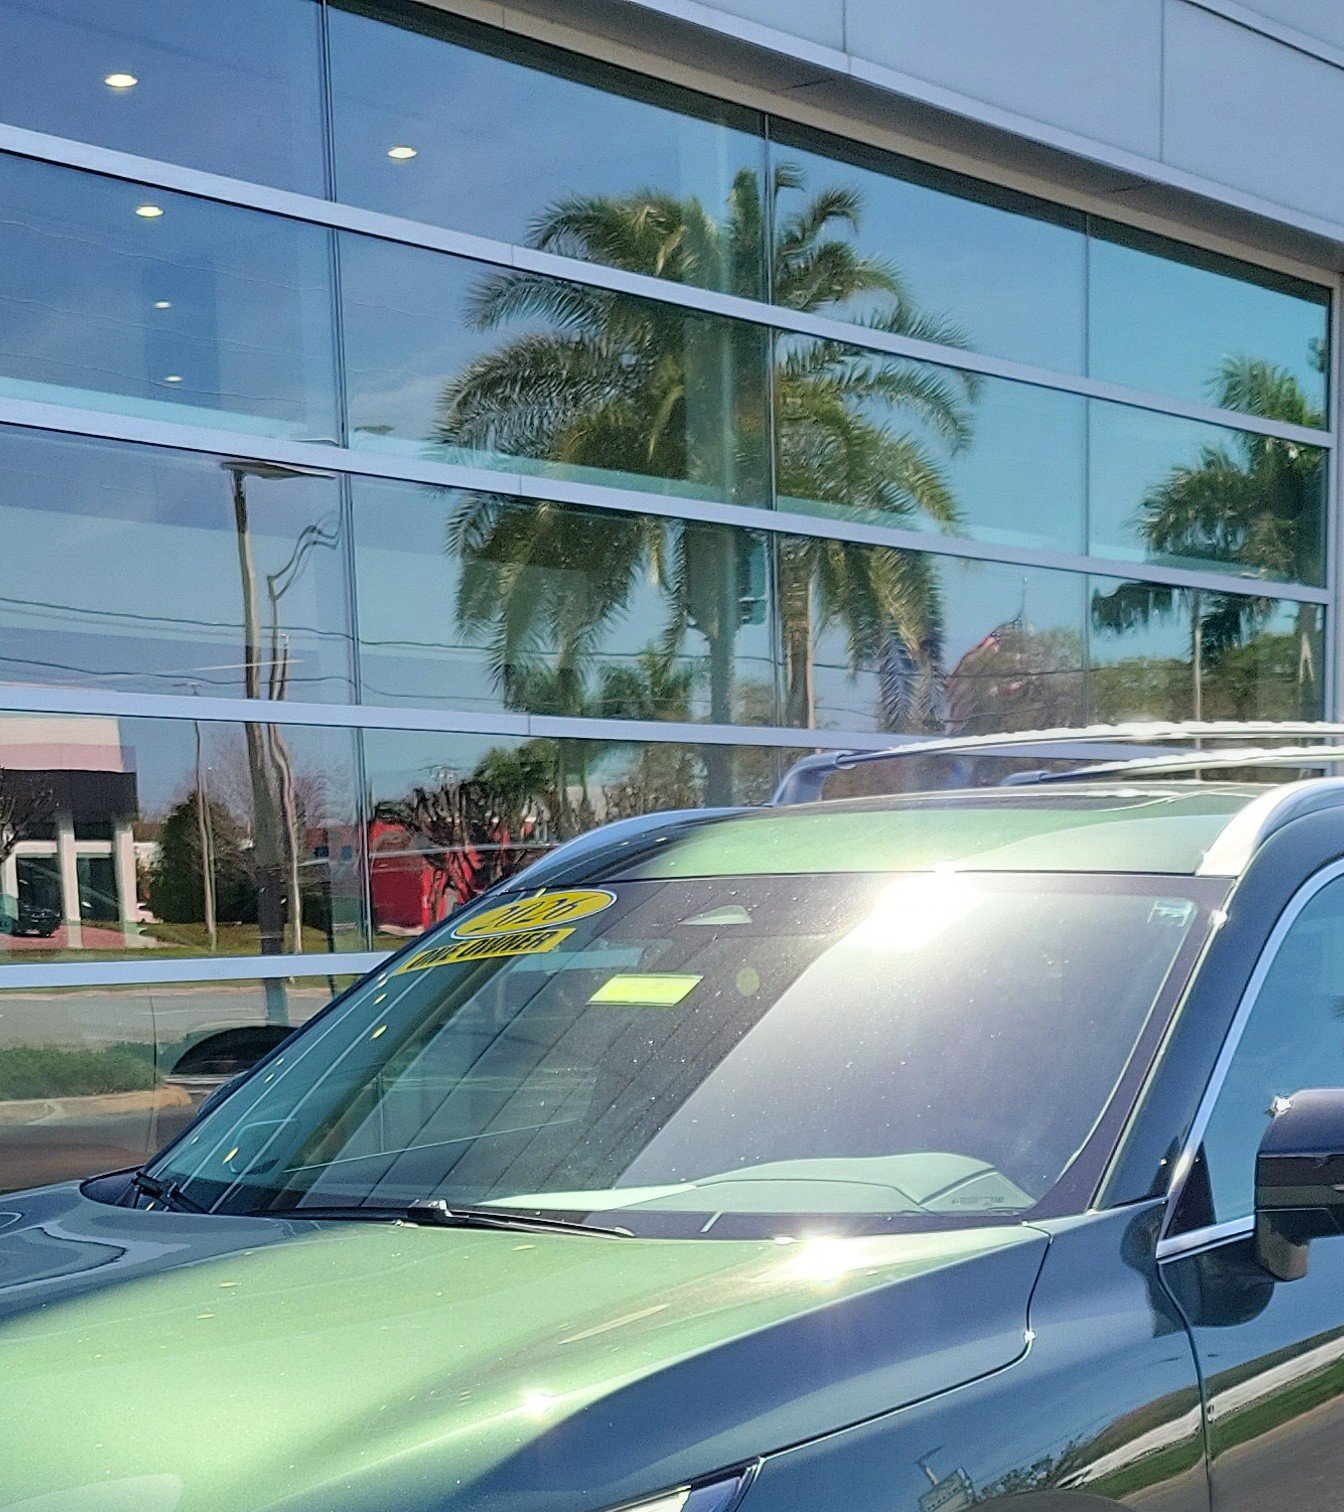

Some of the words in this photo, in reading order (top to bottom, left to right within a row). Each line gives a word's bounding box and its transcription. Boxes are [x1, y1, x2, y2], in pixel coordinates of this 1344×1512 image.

[468, 896, 597, 933] 2026
[406, 942, 468, 969] ONE
[457, 930, 559, 958] OWNER
